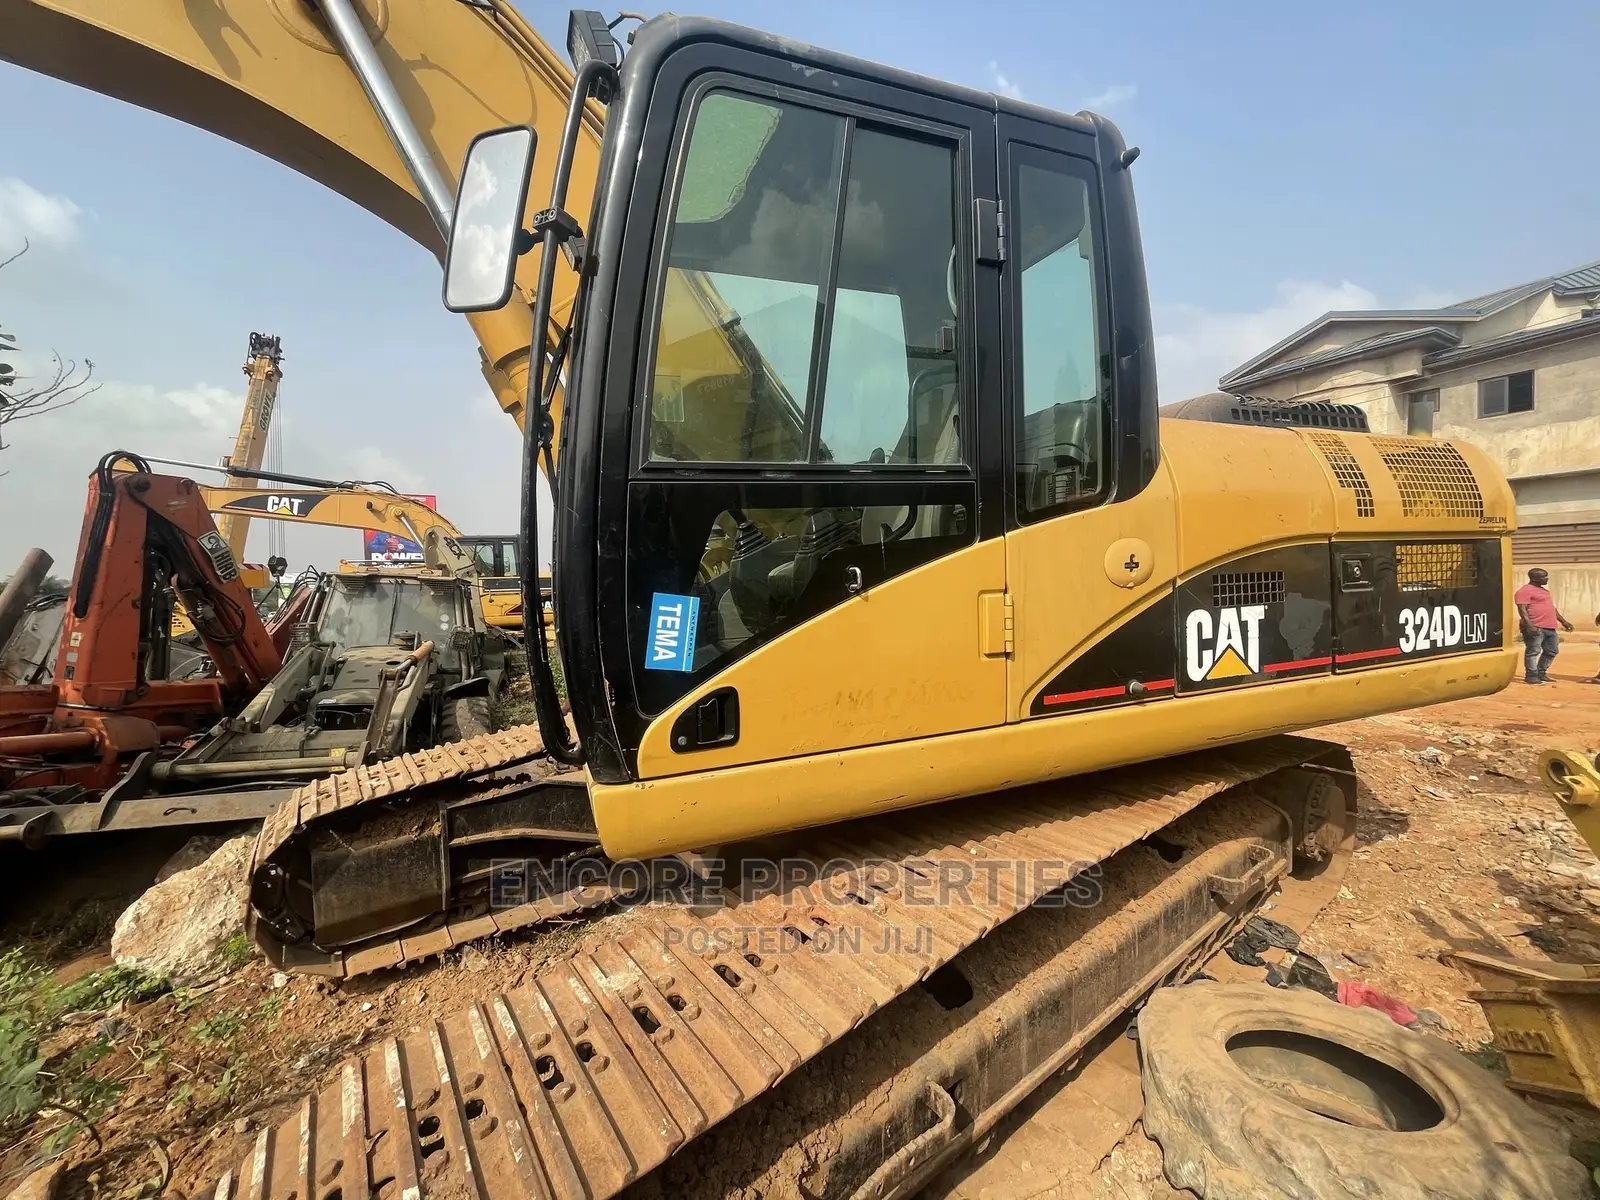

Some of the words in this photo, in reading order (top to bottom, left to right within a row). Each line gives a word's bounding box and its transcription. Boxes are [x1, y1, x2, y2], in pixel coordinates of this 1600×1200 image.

[260, 391, 273, 431] GROVE
[267, 495, 303, 516] CAT
[214, 550, 237, 580] HIAB
[371, 552, 423, 563] POWE
[653, 603, 682, 661] TEMA
[1186, 605, 1266, 682] CAT
[1399, 605, 1462, 653] 324D
